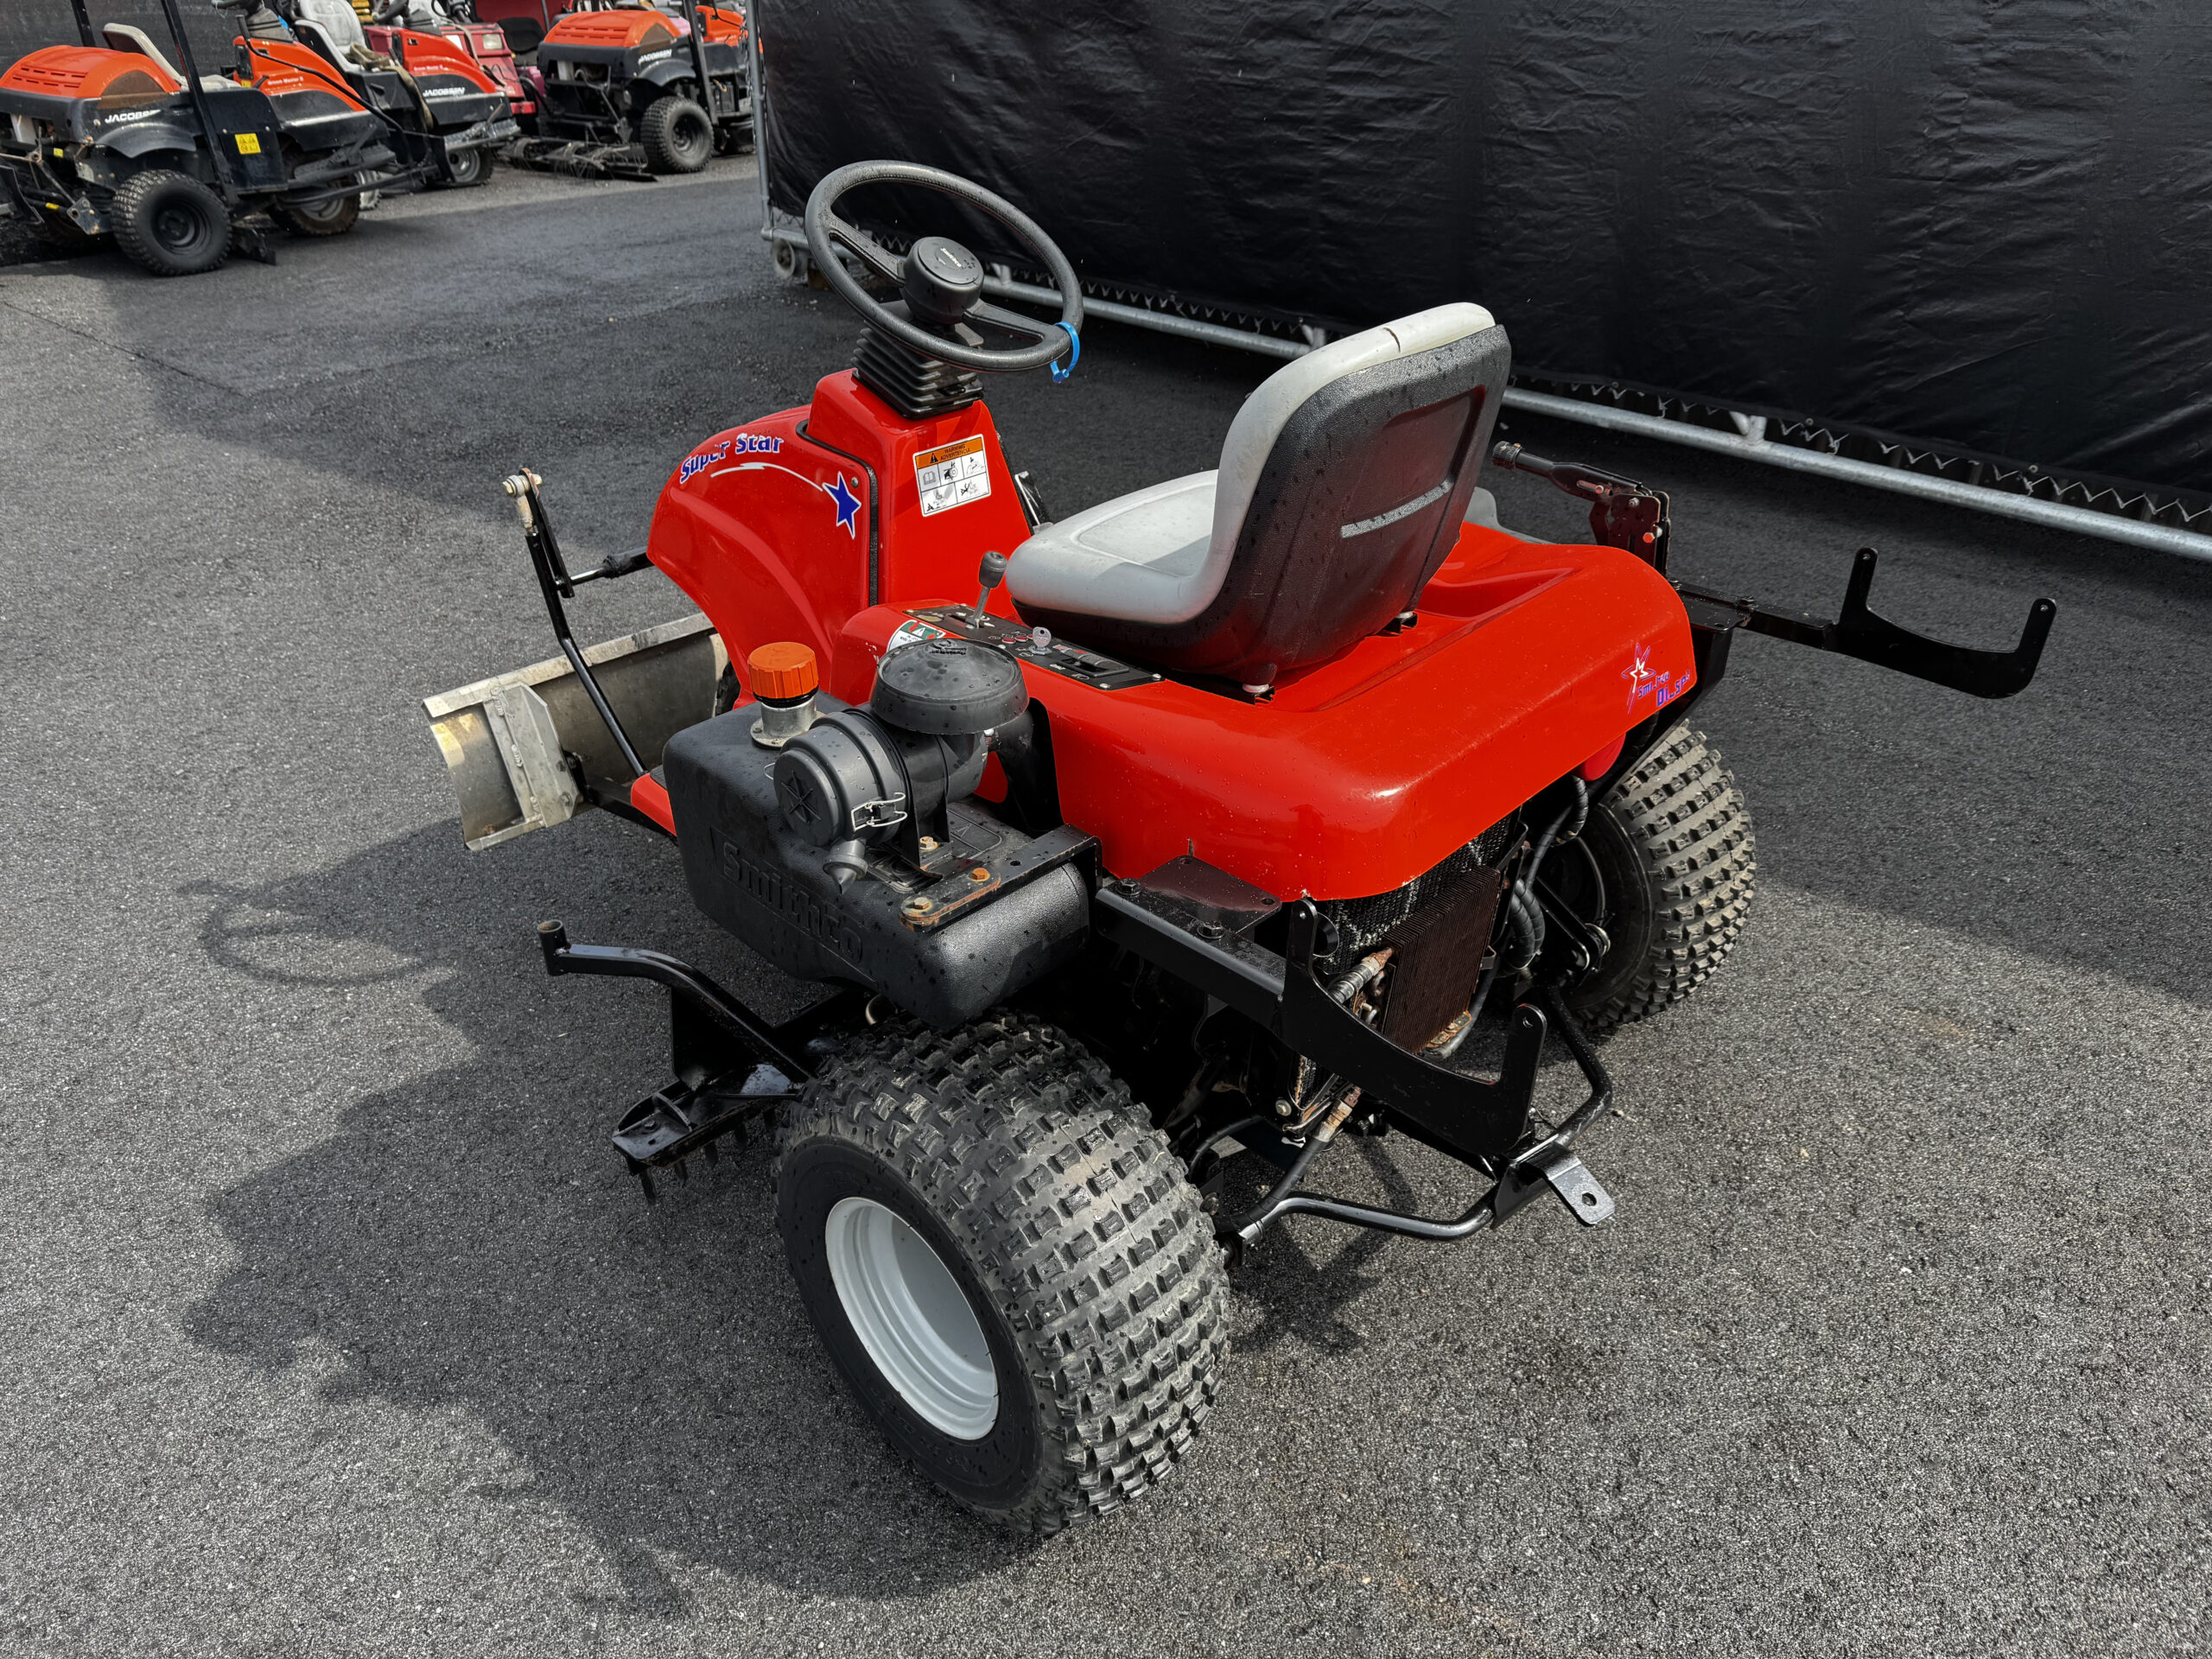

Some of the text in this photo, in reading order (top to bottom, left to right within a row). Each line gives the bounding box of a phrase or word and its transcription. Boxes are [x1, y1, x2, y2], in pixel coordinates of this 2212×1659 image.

[423, 87, 466, 97] JACOBSEN
[105, 109, 162, 124] JACOBS
[940, 448, 971, 461] ADVERTENCIA
[944, 443, 966, 454] WARNING
[680, 433, 785, 484] Super Star
[723, 841, 863, 964] Smithco
